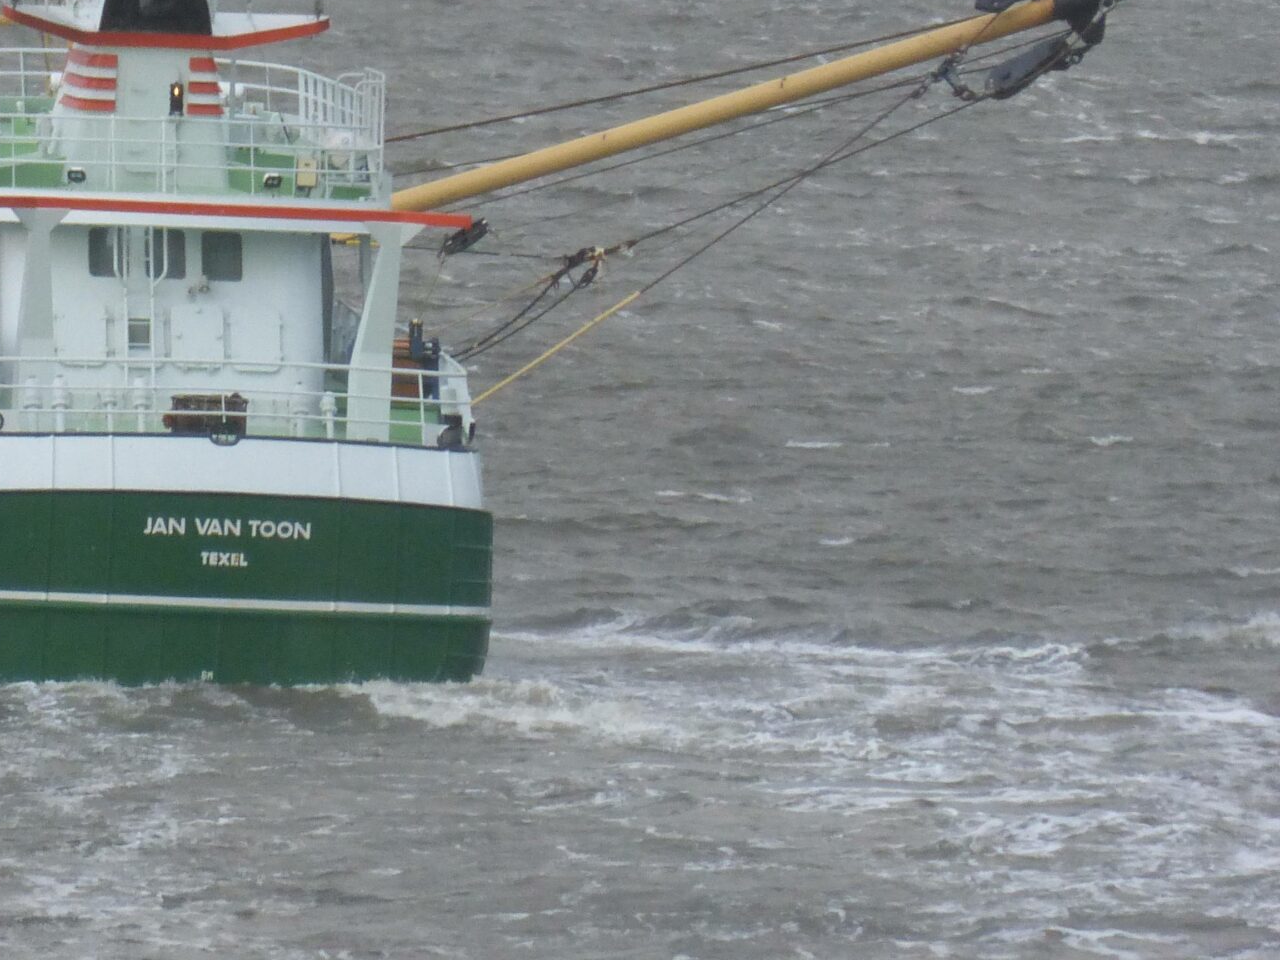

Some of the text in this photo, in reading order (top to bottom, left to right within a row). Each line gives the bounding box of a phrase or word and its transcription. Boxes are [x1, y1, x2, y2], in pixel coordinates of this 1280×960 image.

[143, 516, 312, 540] JAN VAN TOON
[200, 551, 248, 567] TEXEL
